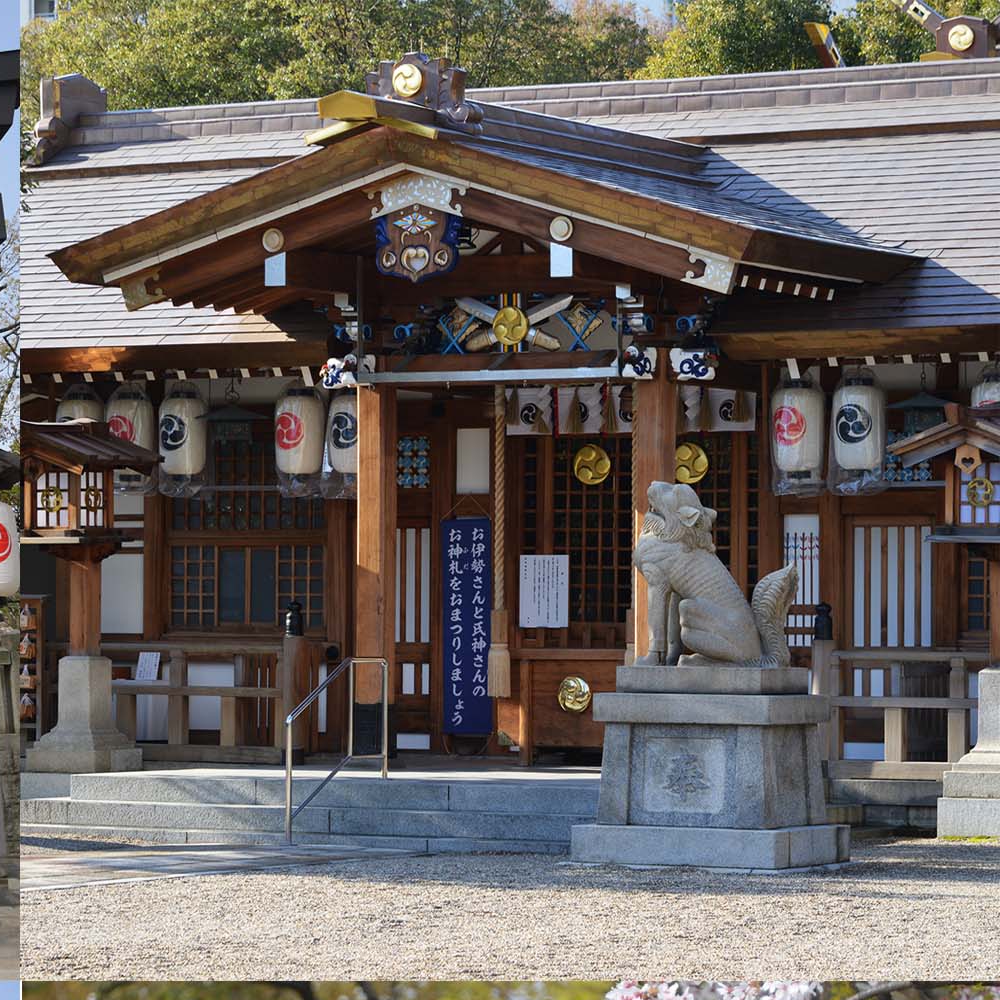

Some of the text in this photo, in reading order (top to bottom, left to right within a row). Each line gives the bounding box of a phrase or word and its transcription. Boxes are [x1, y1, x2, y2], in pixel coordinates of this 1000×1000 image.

[447, 528, 465, 727] お神札をおまつりしましょう
[470, 527, 488, 697] お伊勢さんと氏神さんの
